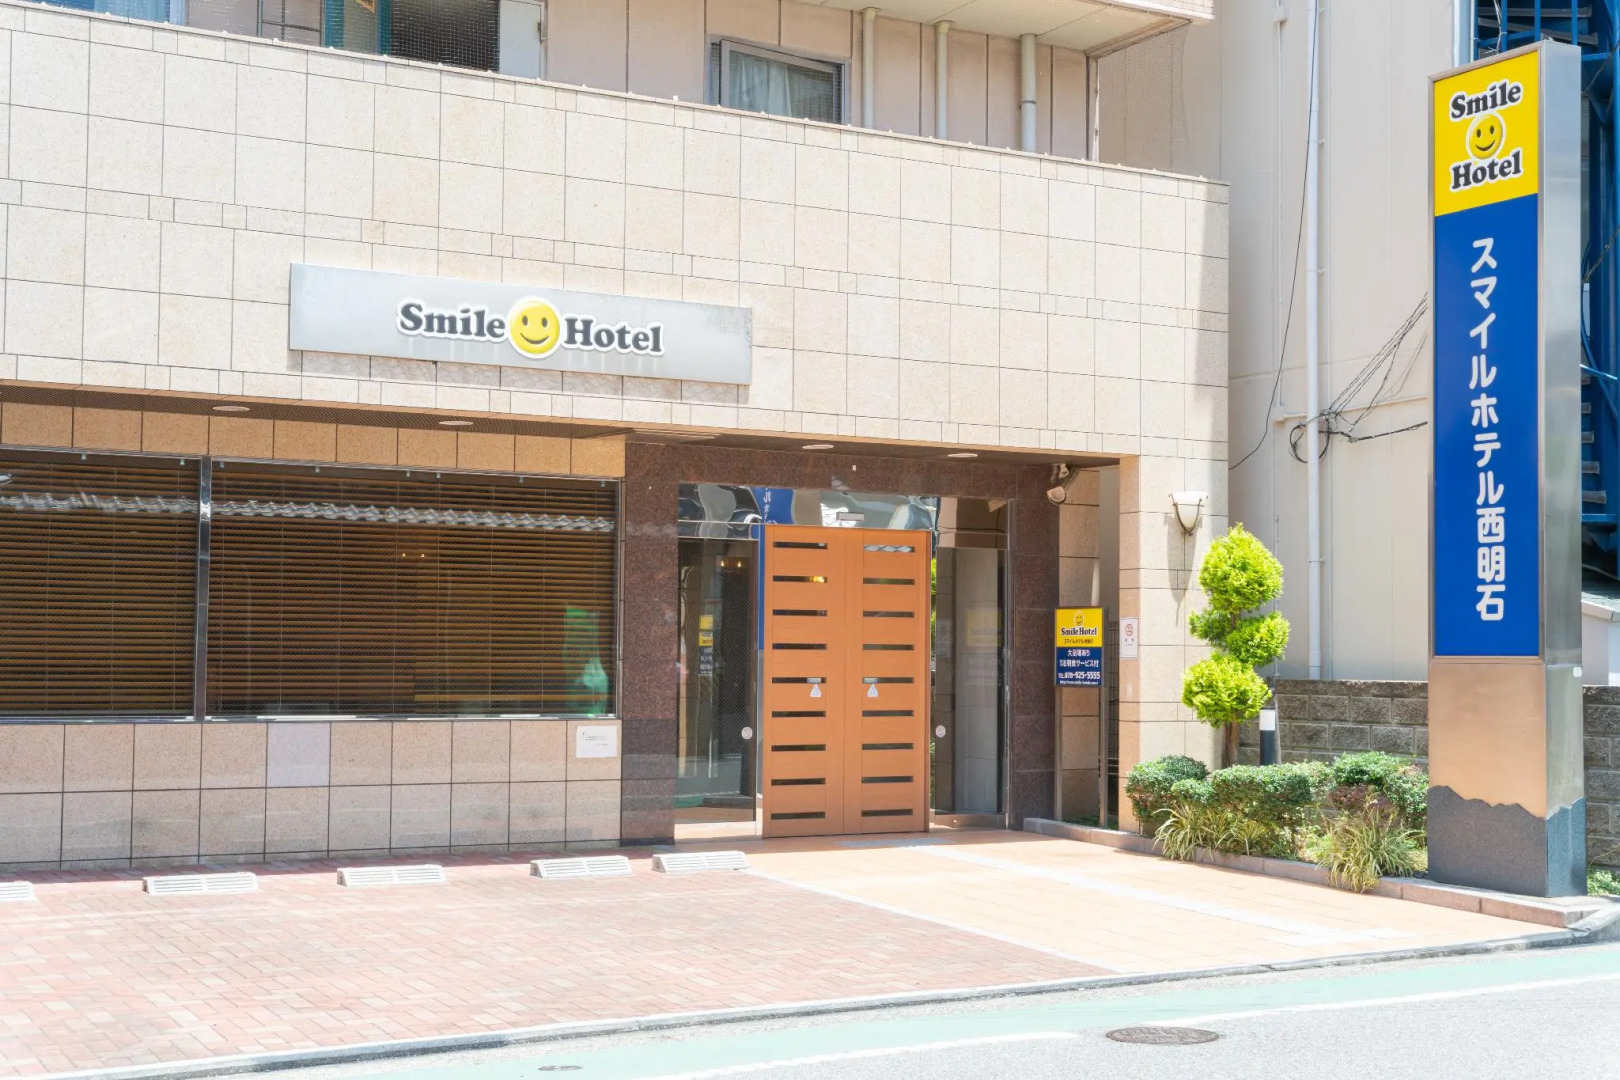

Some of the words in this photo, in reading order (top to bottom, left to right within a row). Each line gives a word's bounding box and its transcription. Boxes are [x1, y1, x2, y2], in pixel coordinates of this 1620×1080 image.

[1451, 80, 1522, 119] Smile
[1451, 149, 1522, 190] Hotel
[399, 302, 505, 339] Smile
[564, 317, 663, 353] Hotel
[1469, 236, 1507, 621] スマイルホテル西明石
[1061, 627, 1078, 636] Smile
[1079, 627, 1097, 636] Hotel
